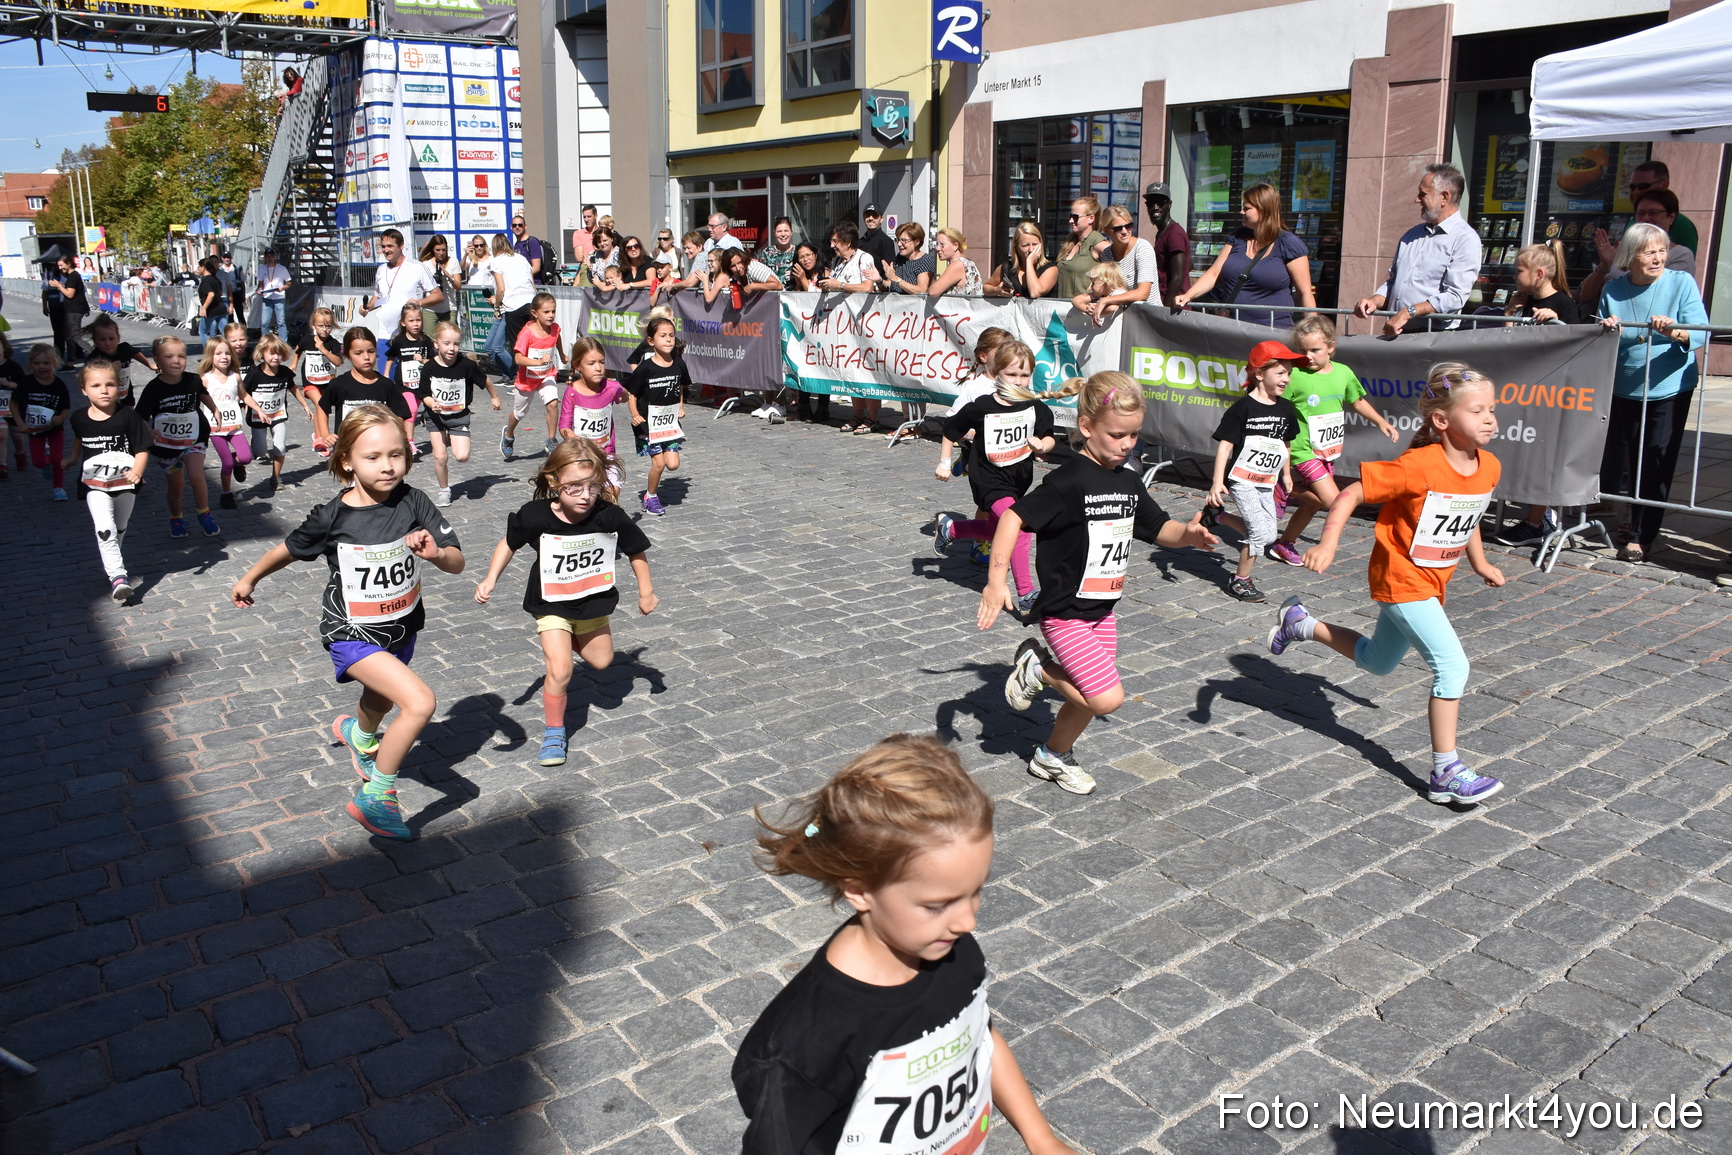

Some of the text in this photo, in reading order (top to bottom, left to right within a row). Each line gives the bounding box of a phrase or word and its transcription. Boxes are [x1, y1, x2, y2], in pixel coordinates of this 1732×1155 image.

[395, 7, 421, 15] inspired
[423, 9, 432, 17] by
[455, 11, 485, 19] concepts
[984, 75, 1042, 93] Unterer Markt 15
[157, 96, 166, 111] 6
[883, 105, 900, 129] G2
[1247, 151, 1279, 160] Radfahren
[589, 311, 640, 336] BOCK
[684, 320, 721, 336] INDUSTRY
[723, 321, 765, 337] LOUNGE
[836, 311, 881, 338] UNS
[309, 363, 331, 373] 7046
[894, 349, 975, 381] BESSE
[435, 388, 461, 401] 7025
[1171, 390, 1185, 406] by
[1187, 394, 1221, 408] smart
[258, 398, 281, 410] 7534
[161, 422, 193, 435] 7032
[580, 417, 609, 433] 7452
[651, 414, 675, 427] 7550
[993, 423, 1028, 445] 7501
[1317, 424, 1345, 443] 7082
[1246, 449, 1282, 469] 7350
[1084, 492, 1129, 504] Neumarkter
[1084, 504, 1123, 516] Stadtlauf
[562, 538, 596, 550] BOCK
[365, 544, 405, 561] BOCK
[552, 548, 605, 574] 7552
[354, 554, 415, 590] 7469
[385, 585, 410, 597] Neumarkt
[379, 599, 407, 613] Frida
[907, 1024, 972, 1079] BOCK
[874, 1046, 979, 1144] 7050
[846, 1135, 861, 1143] B1
